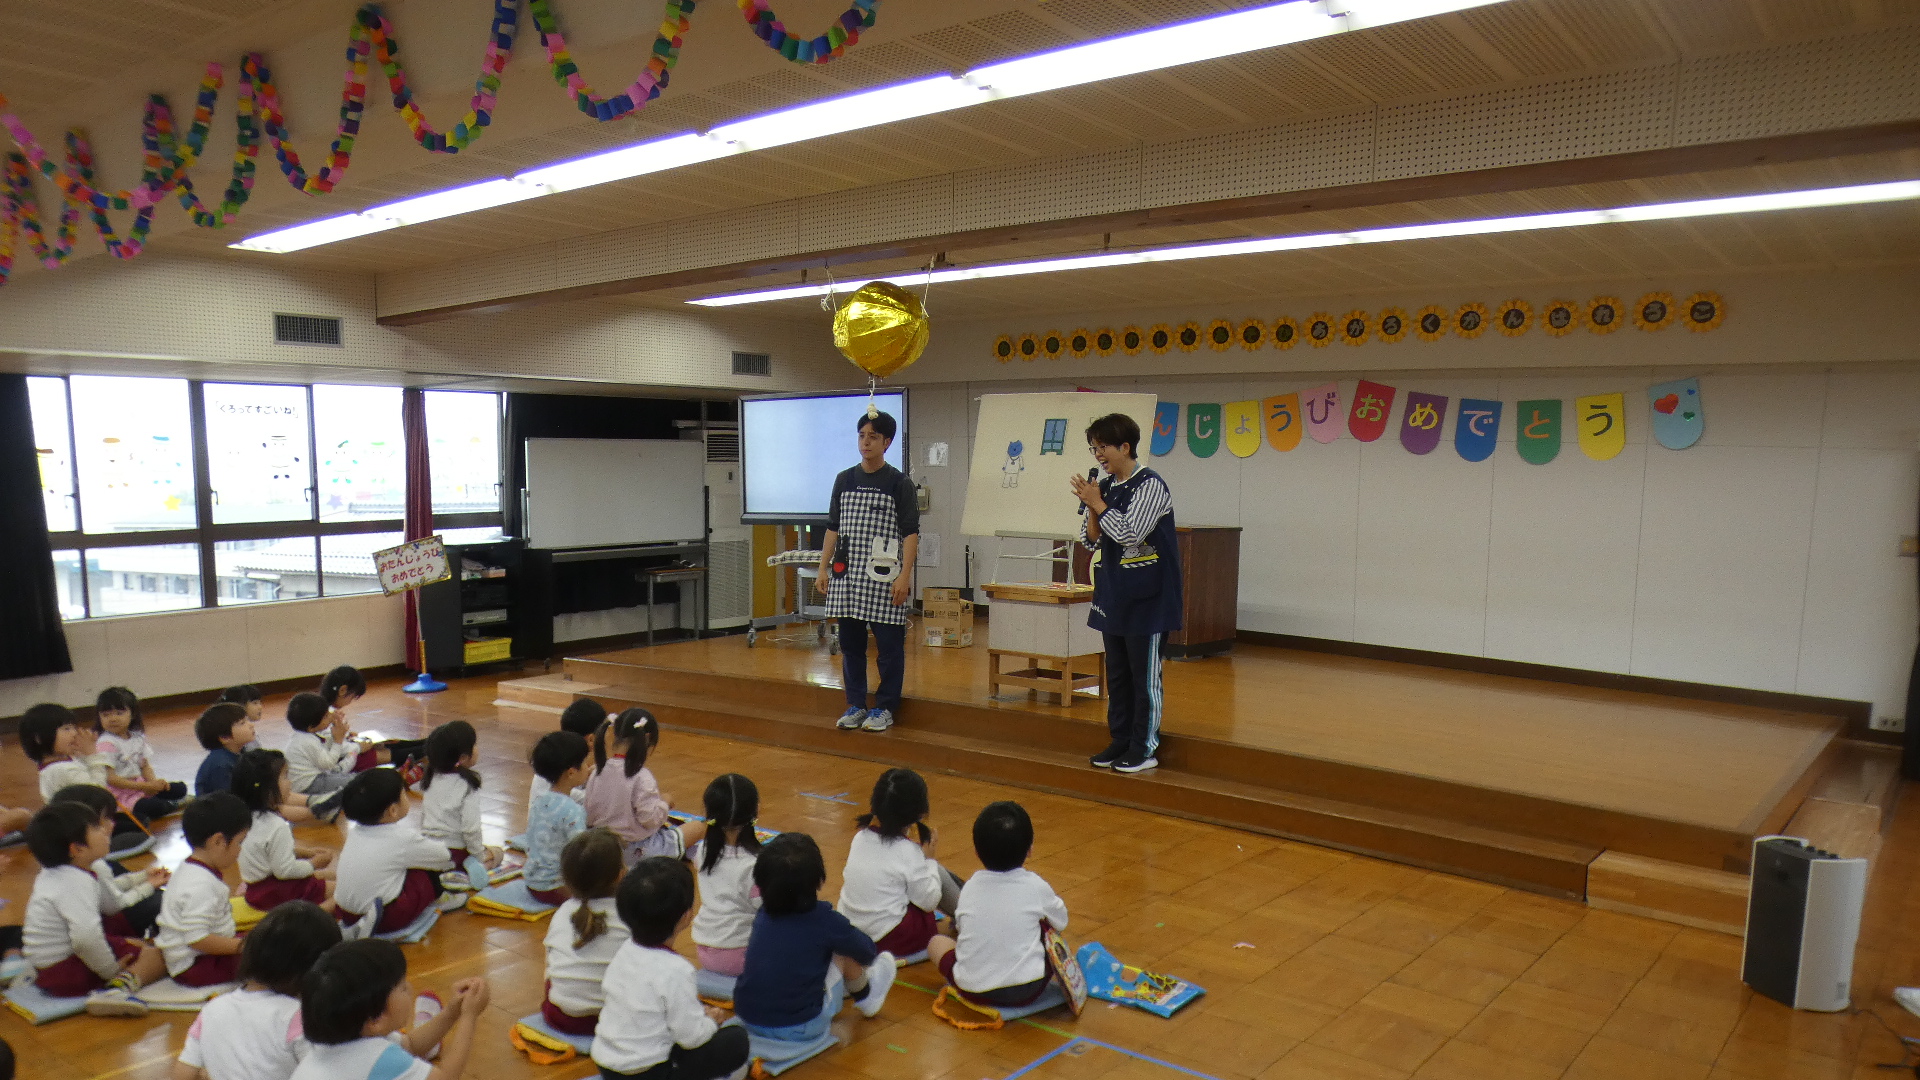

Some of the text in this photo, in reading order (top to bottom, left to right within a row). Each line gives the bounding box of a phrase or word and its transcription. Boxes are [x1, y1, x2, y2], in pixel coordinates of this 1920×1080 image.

[391, 563, 434, 584] おめでとう
